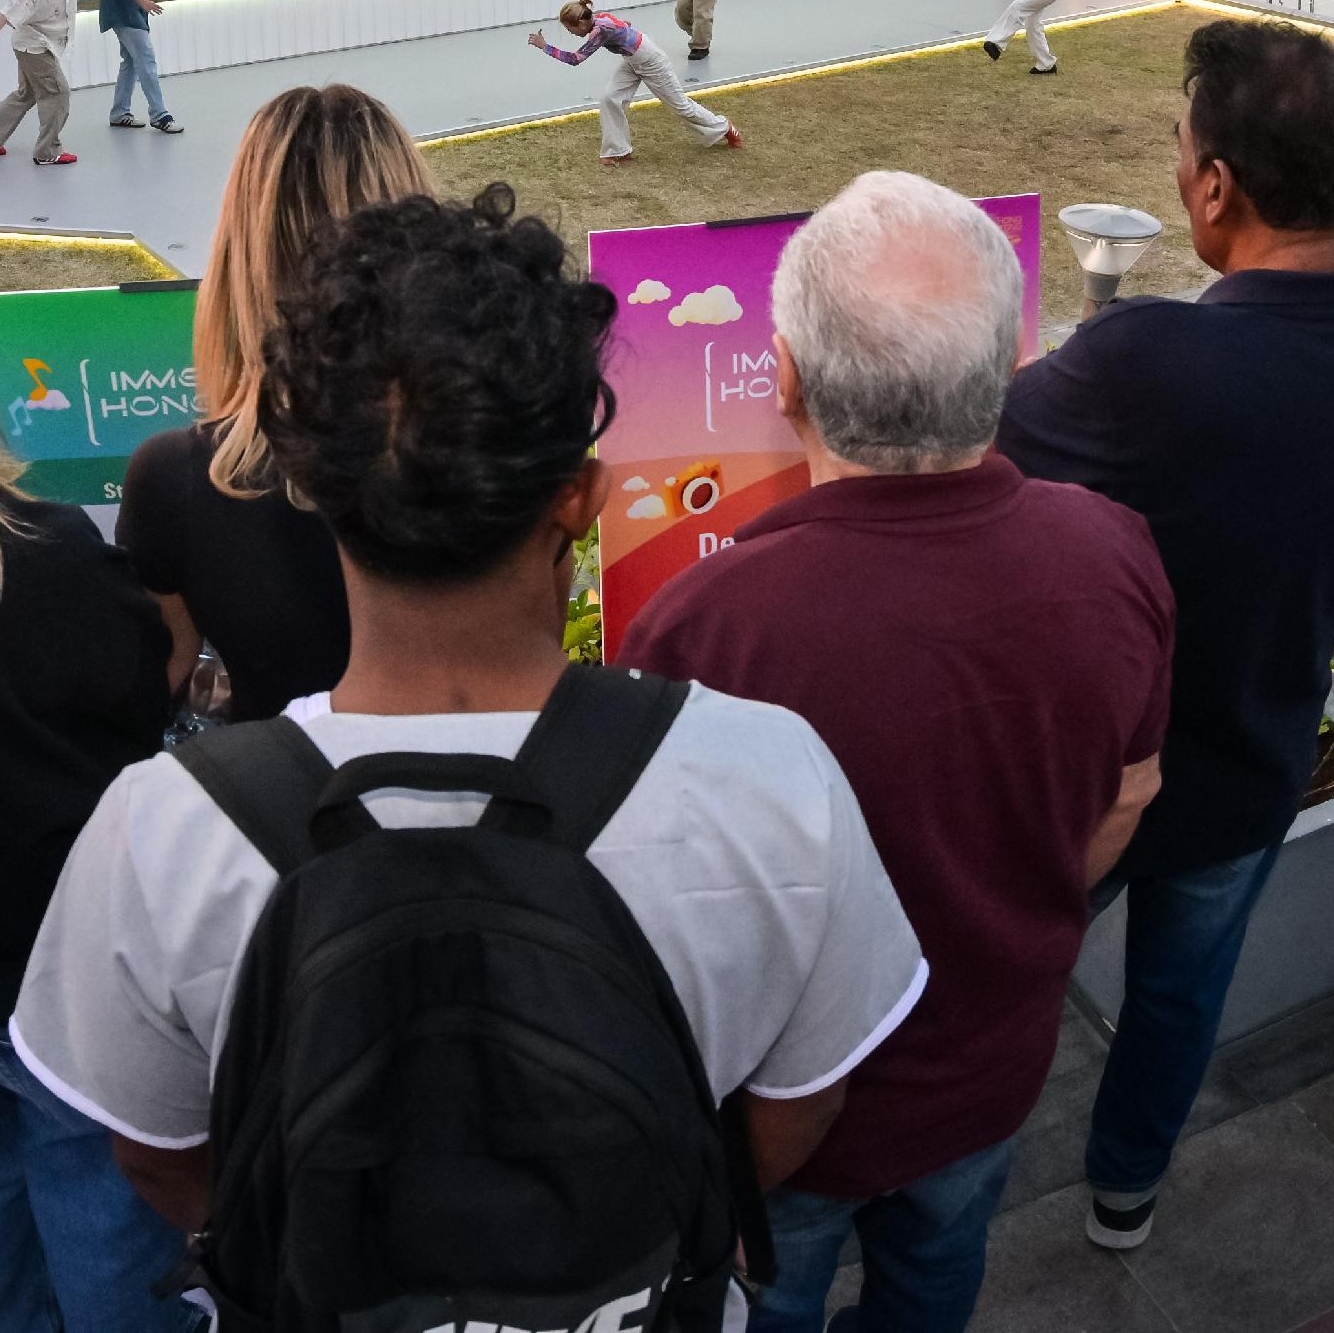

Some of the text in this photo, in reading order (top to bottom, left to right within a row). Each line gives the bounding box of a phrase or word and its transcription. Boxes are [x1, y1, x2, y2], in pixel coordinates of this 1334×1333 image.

[733, 349, 777, 374] IMM
[110, 368, 198, 392] IMME
[720, 377, 779, 402] HO
[104, 482, 123, 500] St
[698, 532, 735, 559] De
